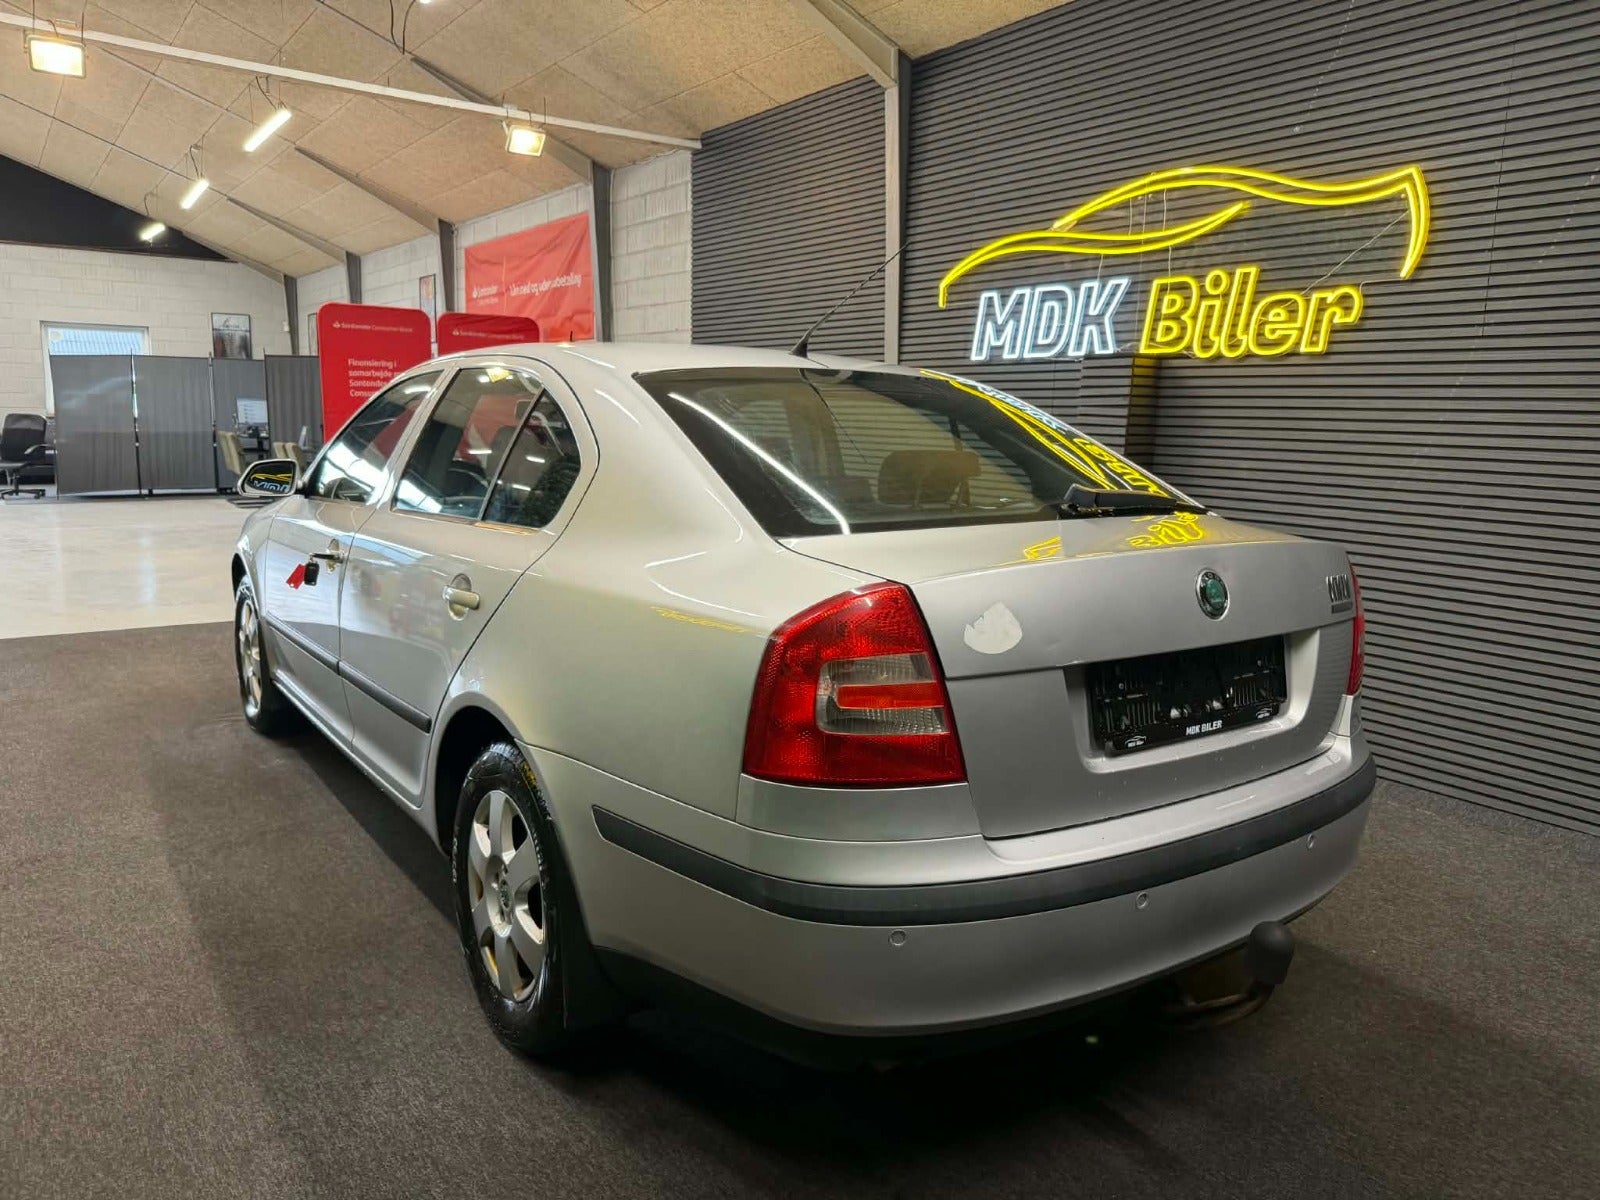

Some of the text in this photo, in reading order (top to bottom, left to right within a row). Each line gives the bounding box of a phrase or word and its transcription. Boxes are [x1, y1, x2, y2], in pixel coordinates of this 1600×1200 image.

[970, 265, 1363, 361] MDK Biler
[348, 358, 394, 369] Finansiering
[348, 370, 392, 379] samarbejde
[1185, 720, 1223, 736] MDK BILER
